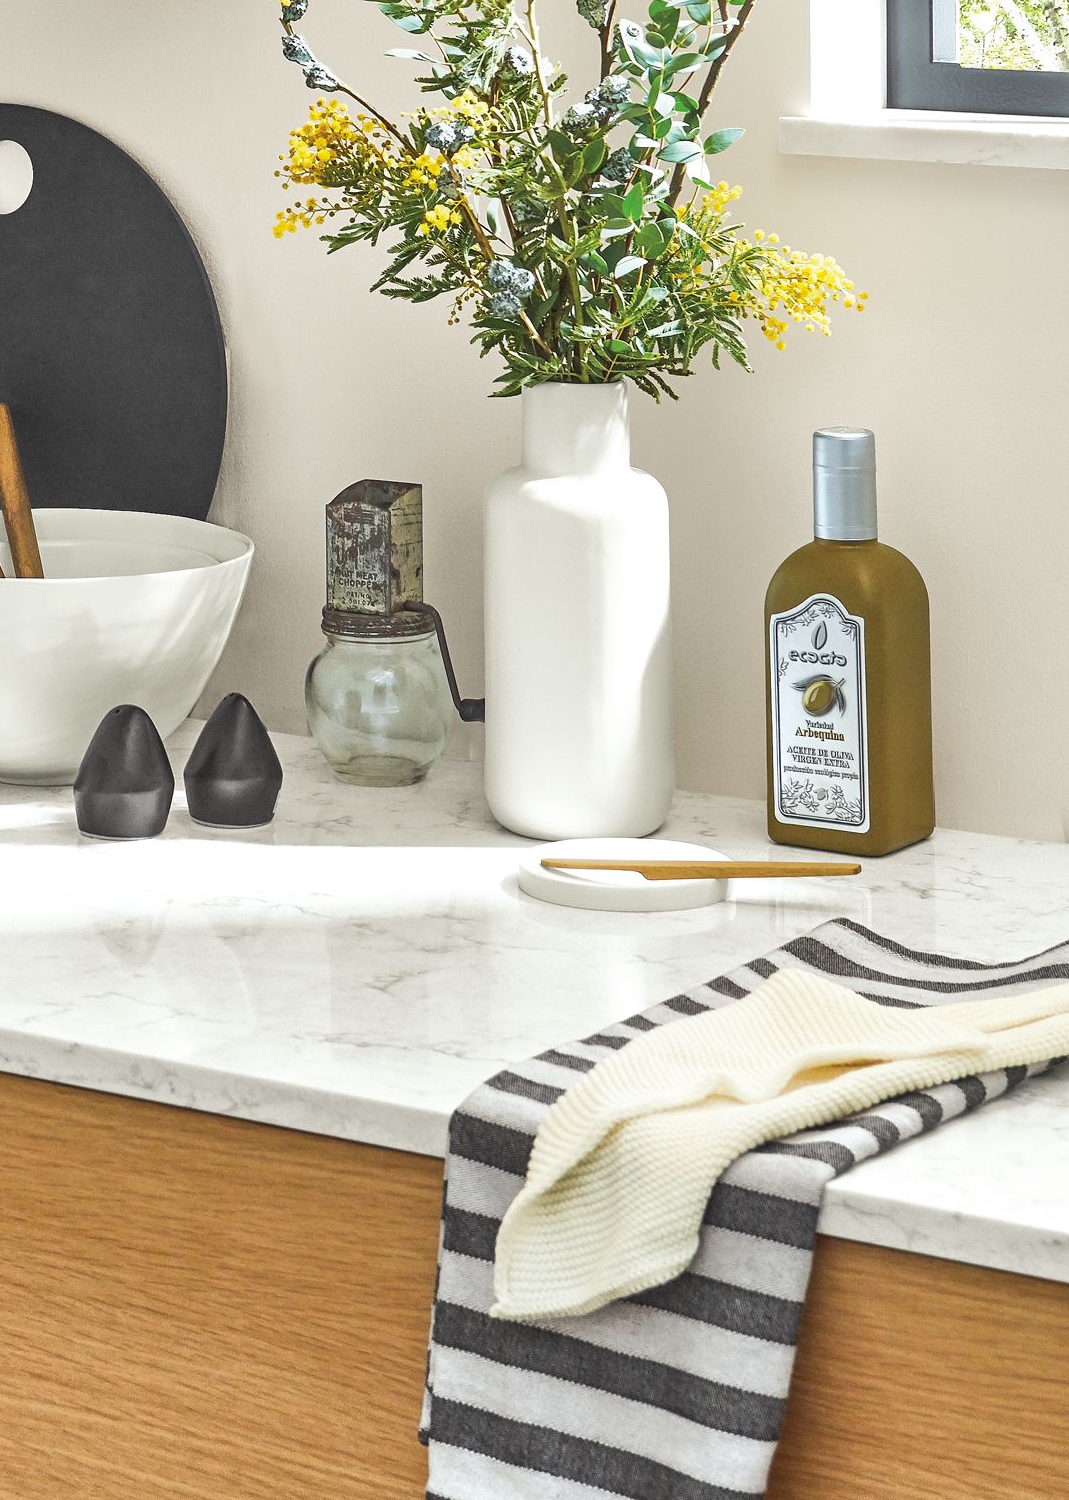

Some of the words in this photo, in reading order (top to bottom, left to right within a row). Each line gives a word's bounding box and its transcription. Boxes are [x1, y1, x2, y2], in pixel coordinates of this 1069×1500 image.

[356, 571, 378, 580] MEAT
[338, 578, 379, 589] CHOPPE
[805, 719, 834, 730] Variedad
[795, 726, 845, 741] Arbequina
[787, 745, 816, 756] ACEITE
[817, 749, 828, 757] DE
[830, 750, 854, 760] OLIVA
[792, 754, 822, 764] VIRGEN
[824, 758, 850, 768] EXTRA
